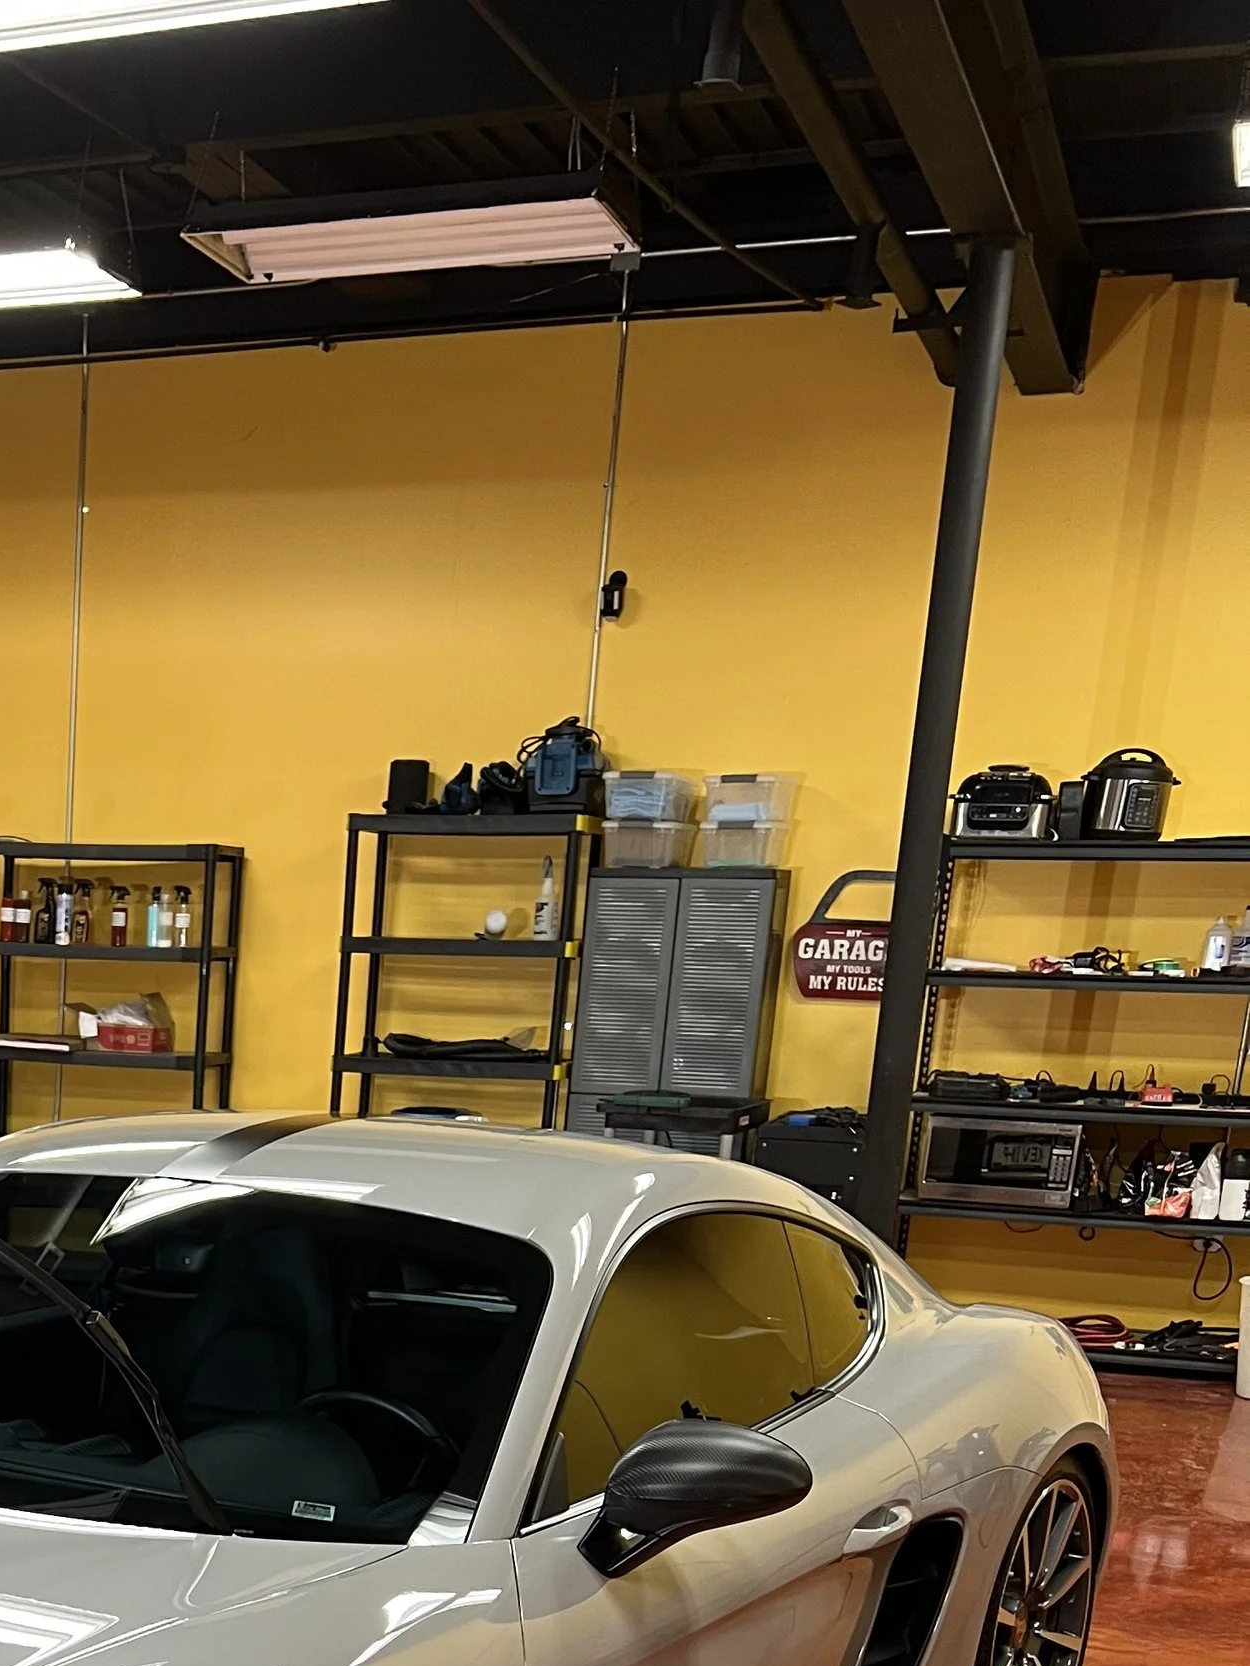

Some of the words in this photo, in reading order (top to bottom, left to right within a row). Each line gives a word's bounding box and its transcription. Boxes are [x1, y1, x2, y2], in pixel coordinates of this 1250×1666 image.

[846, 929, 862, 937] MY
[798, 937, 888, 961] GARAG
[826, 964, 840, 973] MY
[843, 965, 871, 974] TOOLS
[808, 975, 833, 990] MY
